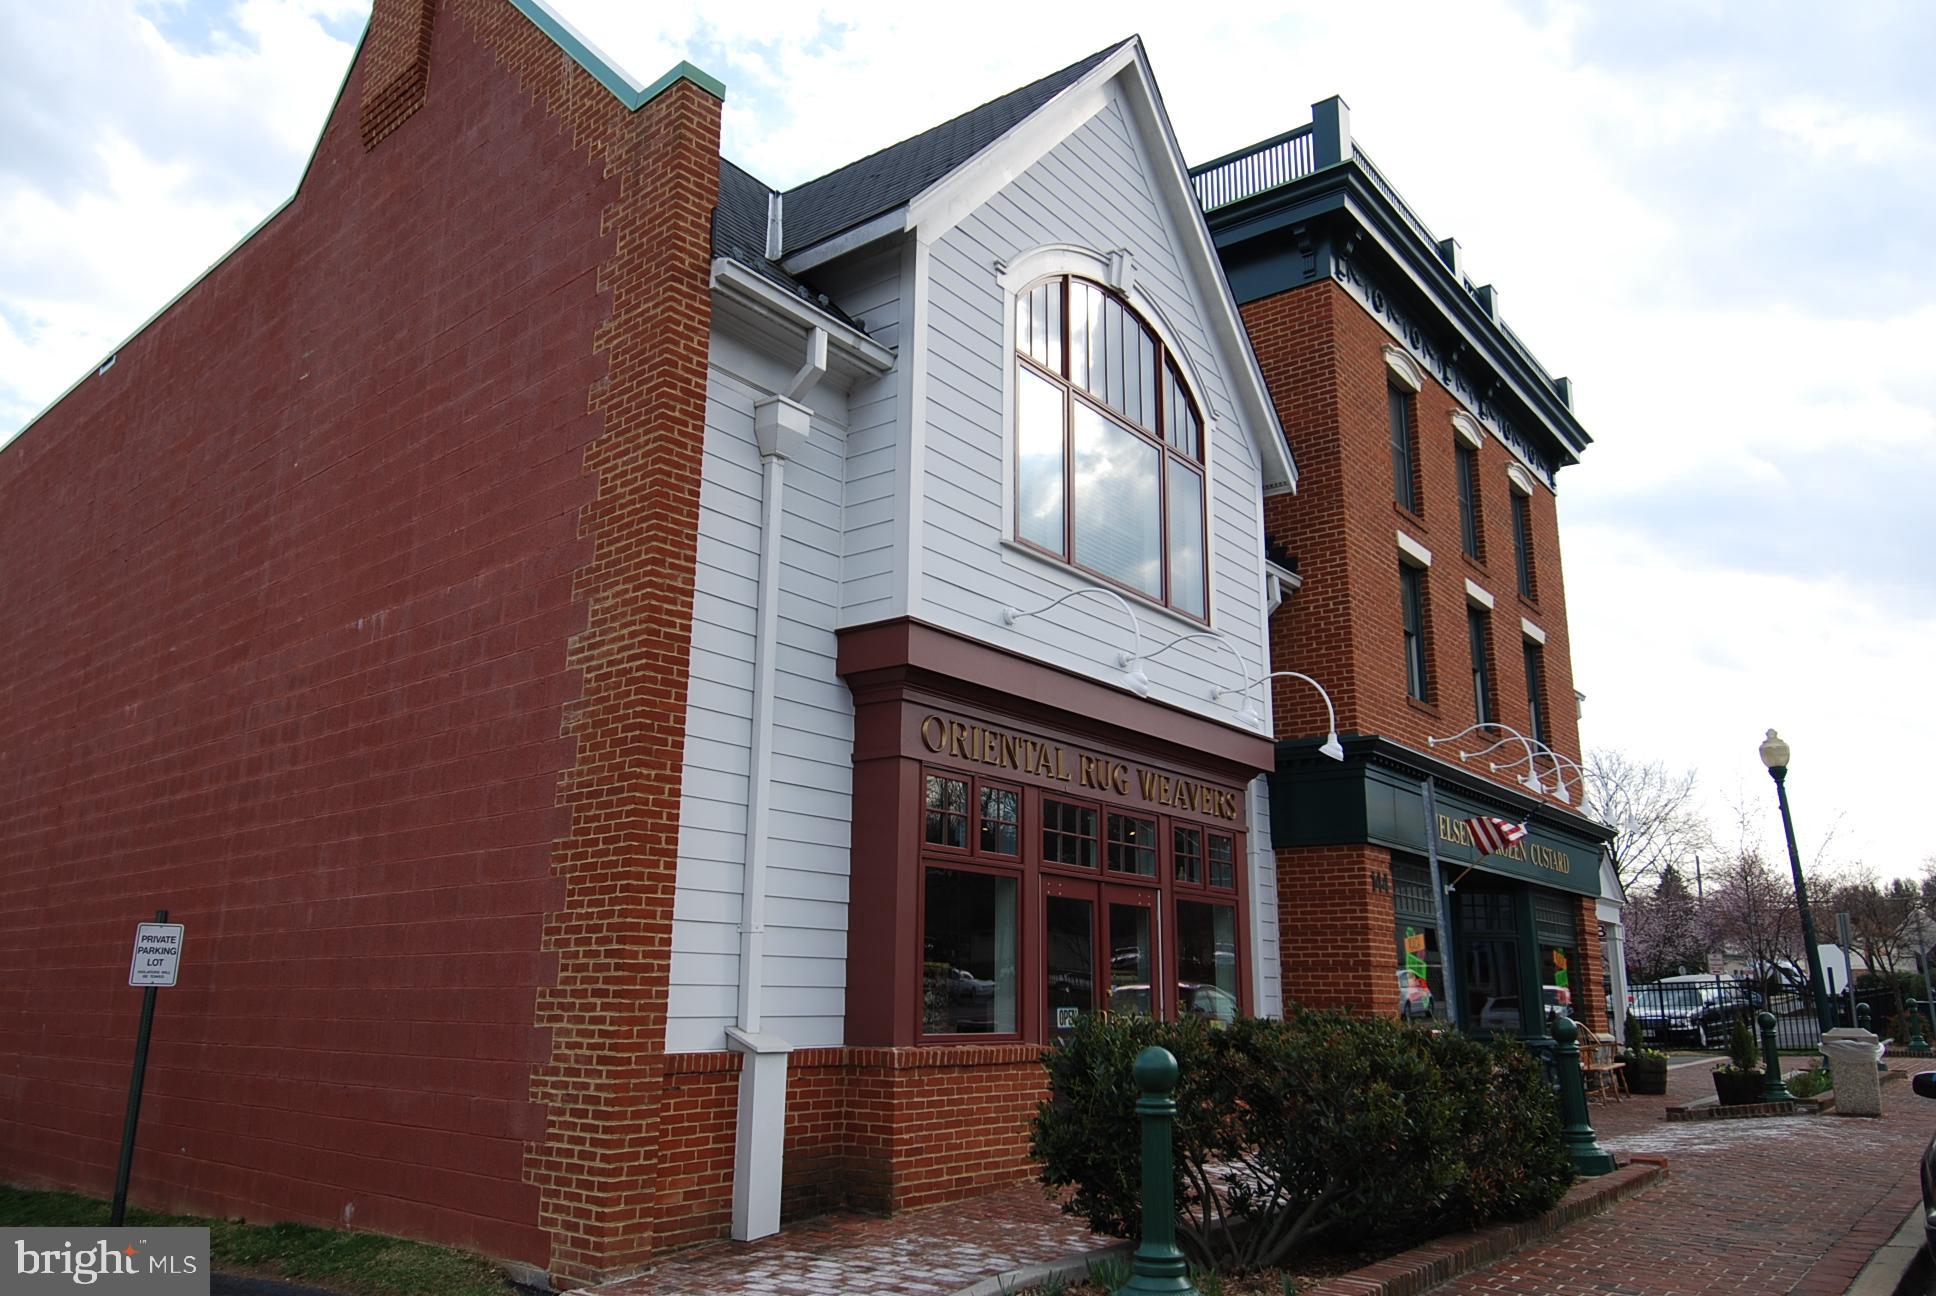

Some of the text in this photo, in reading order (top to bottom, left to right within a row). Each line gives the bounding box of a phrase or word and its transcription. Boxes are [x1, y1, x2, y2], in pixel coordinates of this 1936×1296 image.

[921, 715, 1238, 820] ORIENTAL RUG WEAVERS
[1530, 843, 1571, 874] CUSTARD
[141, 934, 177, 944] PRIVATE
[137, 946, 177, 956] PARKING
[146, 958, 164, 967] LOT
